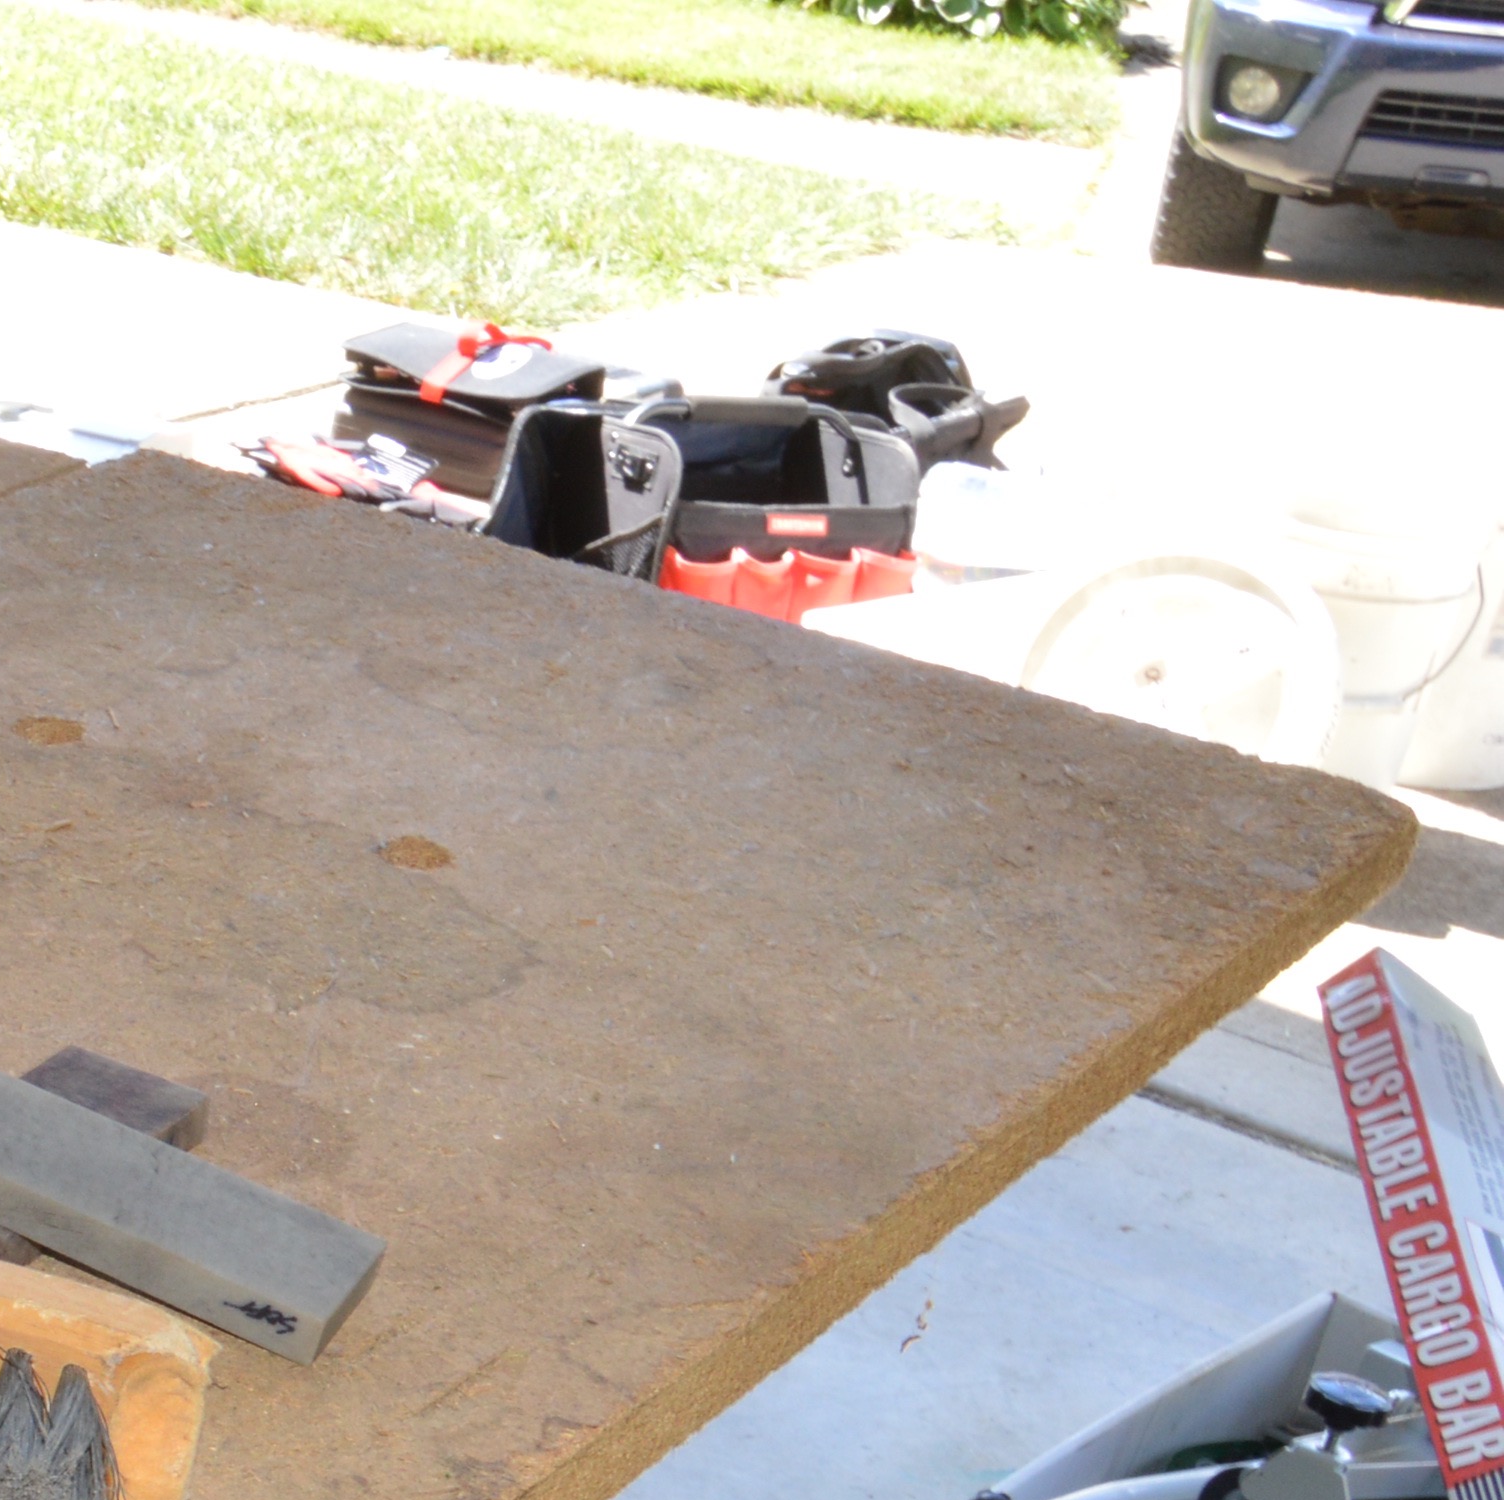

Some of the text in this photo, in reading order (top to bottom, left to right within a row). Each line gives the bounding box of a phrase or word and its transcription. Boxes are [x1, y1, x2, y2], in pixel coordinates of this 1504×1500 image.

[1326, 974, 1438, 1221] ADJUSTABLE
[1388, 1219, 1480, 1367] CARGO
[1428, 1368, 1504, 1471] BAR
